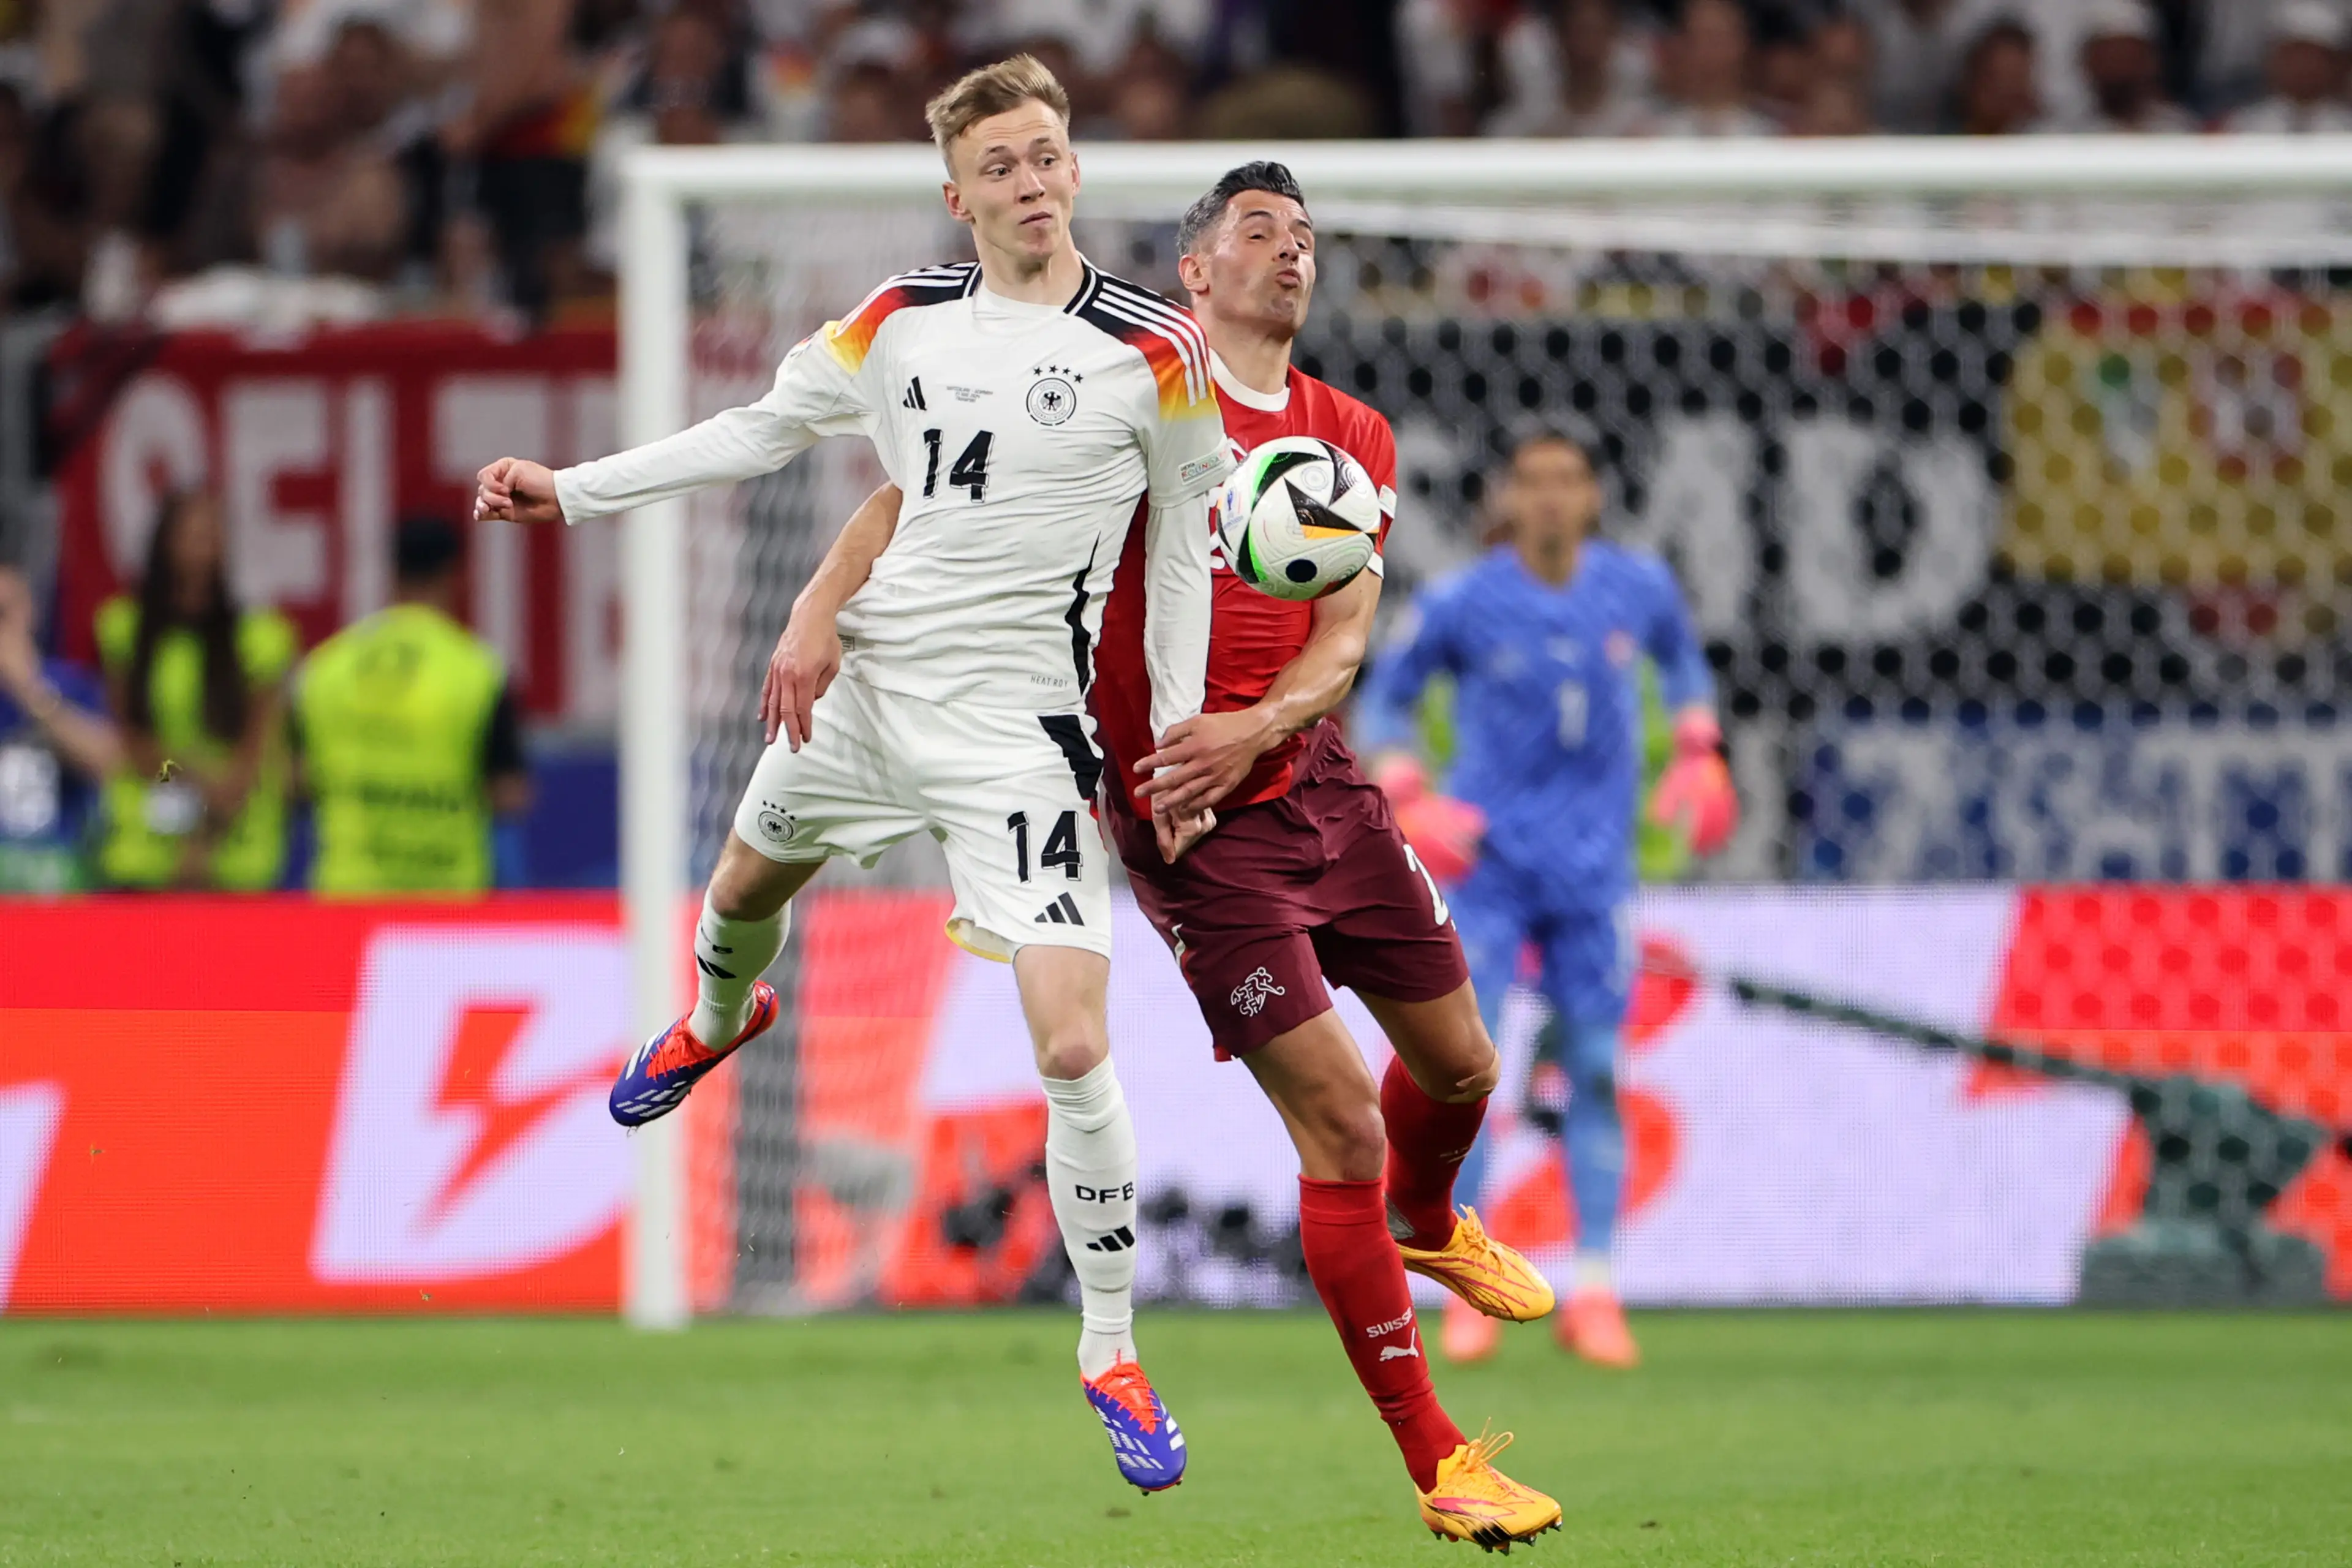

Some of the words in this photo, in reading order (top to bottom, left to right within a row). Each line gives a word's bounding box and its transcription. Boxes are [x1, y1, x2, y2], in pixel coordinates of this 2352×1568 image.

[923, 428, 995, 503] 14
[1008, 810, 1083, 883] 14
[1075, 1181, 1134, 1204] DFB
